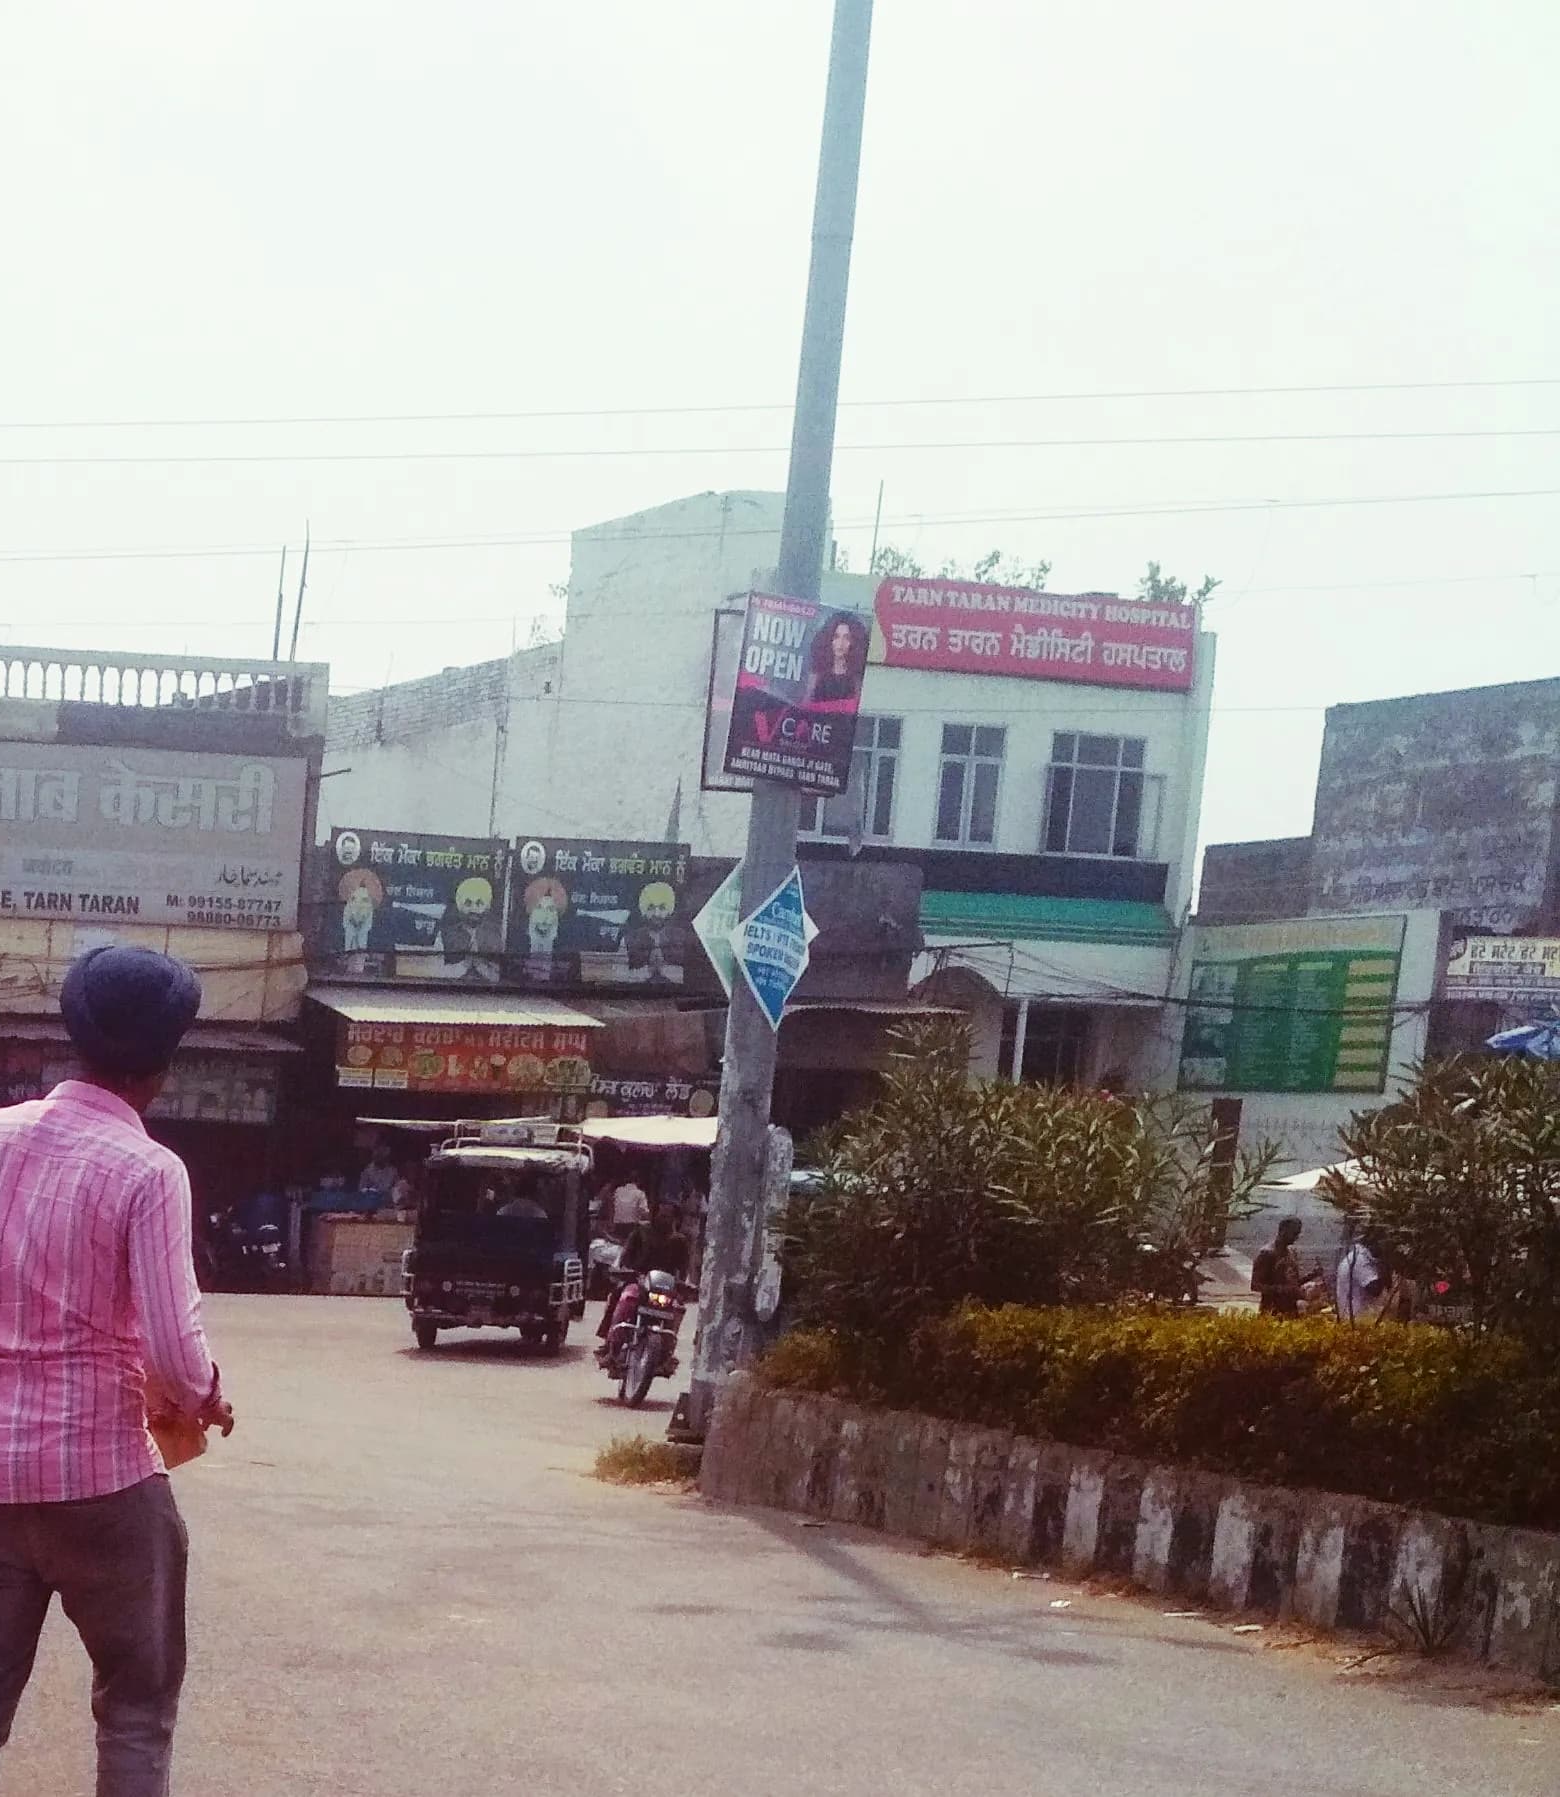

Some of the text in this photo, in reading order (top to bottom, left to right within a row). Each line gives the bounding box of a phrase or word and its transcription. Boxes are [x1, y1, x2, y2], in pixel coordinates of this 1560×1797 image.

[891, 586, 1192, 631] TARN TARAN MEDICITY HOSPITAL
[753, 614, 808, 649] NOW
[891, 623, 941, 652] ਤਰਨ
[947, 628, 1003, 657] ਤਾਰਨ
[1101, 640, 1188, 673] ਹਸਪਤਾਲ
[745, 644, 804, 681] OPEN
[97, 760, 282, 835] केसरी
[23, 893, 72, 912] TARN
[78, 895, 140, 915] TARAN
[743, 922, 772, 942] IELTS
[747, 942, 785, 962] SPOKEN
